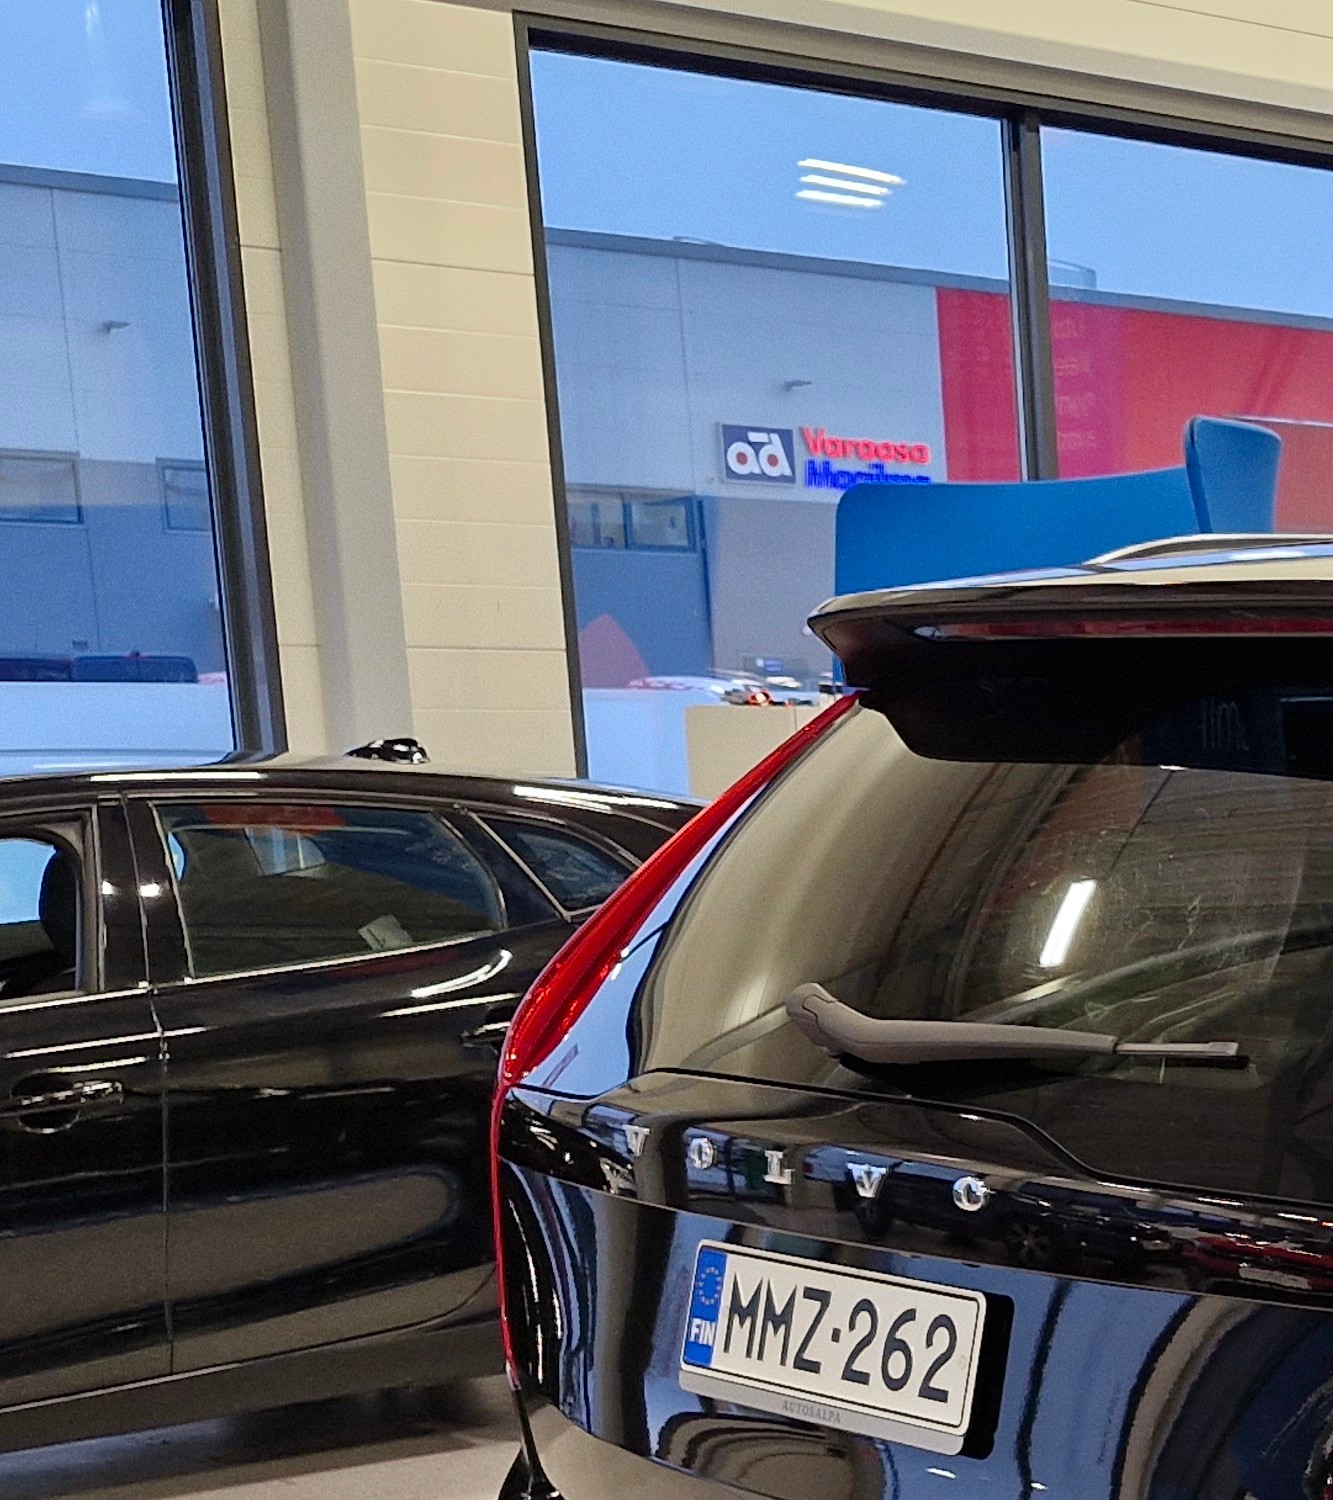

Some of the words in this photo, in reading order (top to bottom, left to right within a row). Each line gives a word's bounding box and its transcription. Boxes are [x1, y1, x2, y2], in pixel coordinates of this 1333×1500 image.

[622, 1123, 990, 1212] VOLVO
[689, 1317, 717, 1346] FIN
[723, 1271, 959, 1404] MMZ-262
[782, 1400, 842, 1425] AUTOSALPA
